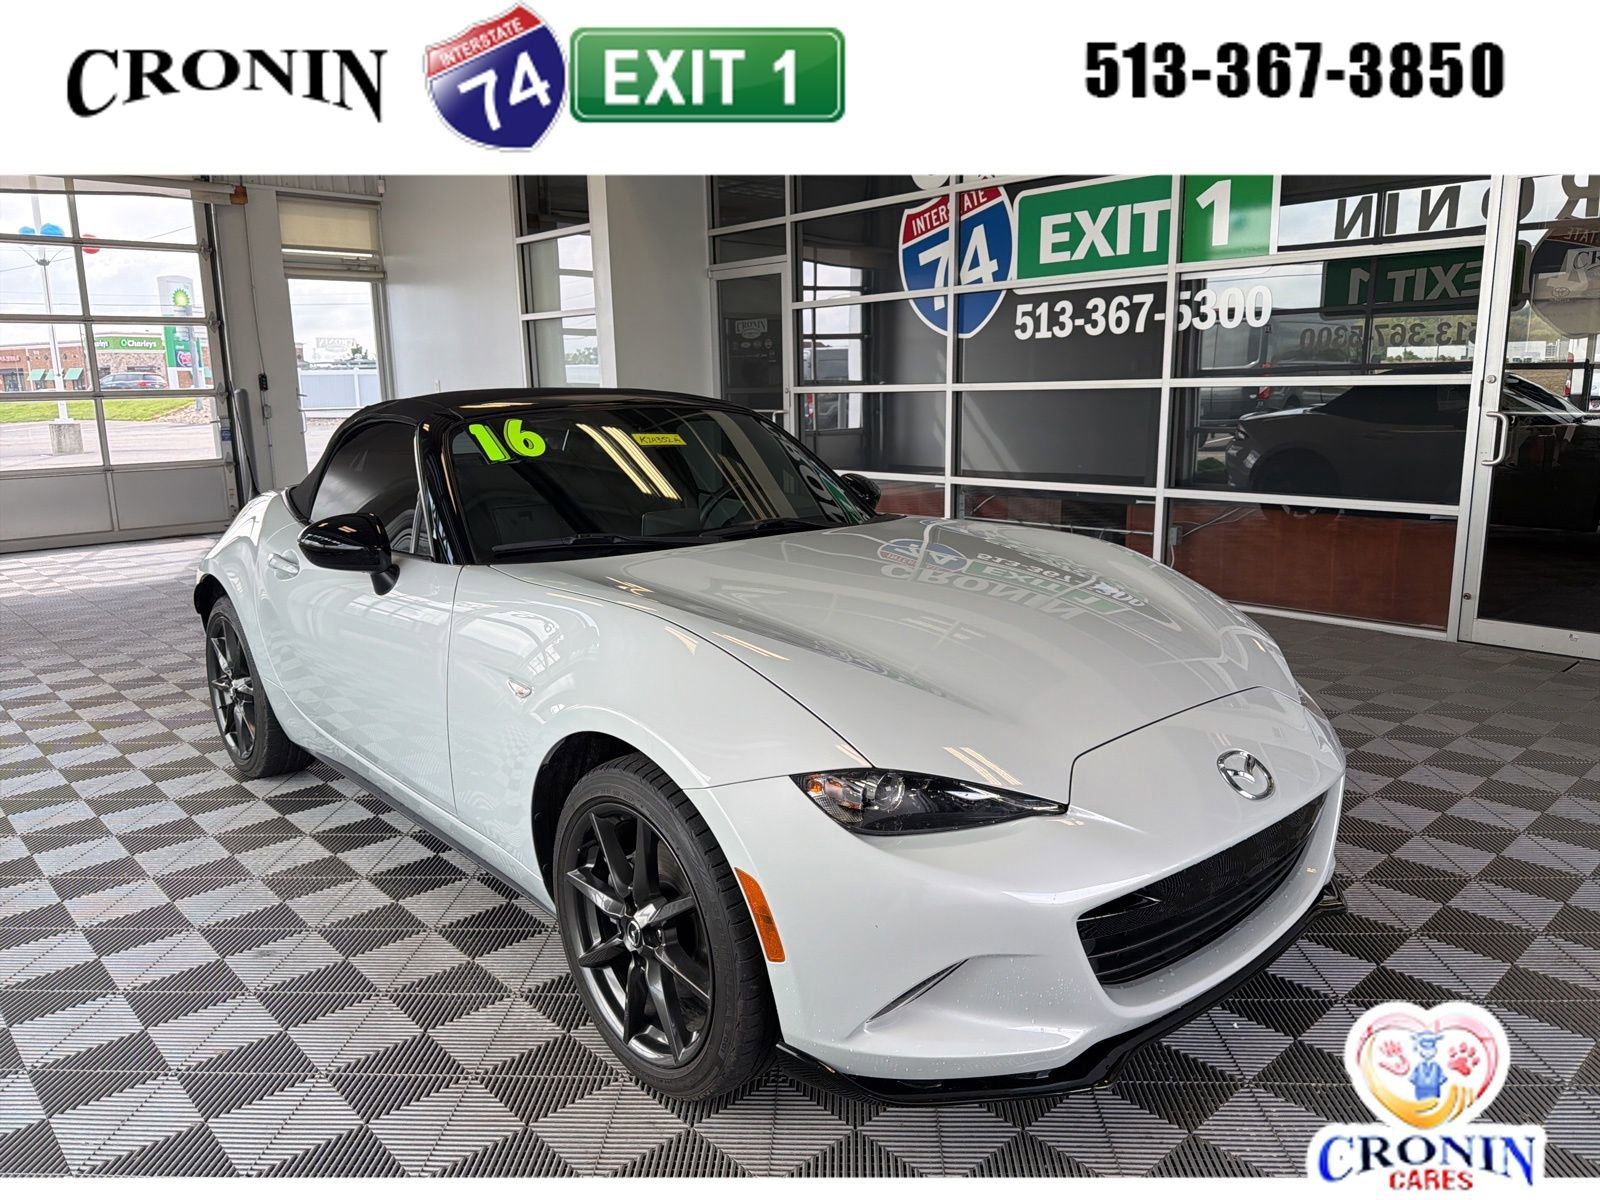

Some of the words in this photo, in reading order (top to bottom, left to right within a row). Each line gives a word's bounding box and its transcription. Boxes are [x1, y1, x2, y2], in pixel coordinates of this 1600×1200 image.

[911, 189, 988, 236] INTERATE
[1039, 199, 1170, 264] EXIT
[1196, 179, 1232, 246] 1
[918, 224, 998, 311] 74
[1014, 286, 1272, 340] 513-367-5300
[468, 418, 546, 461] 16
